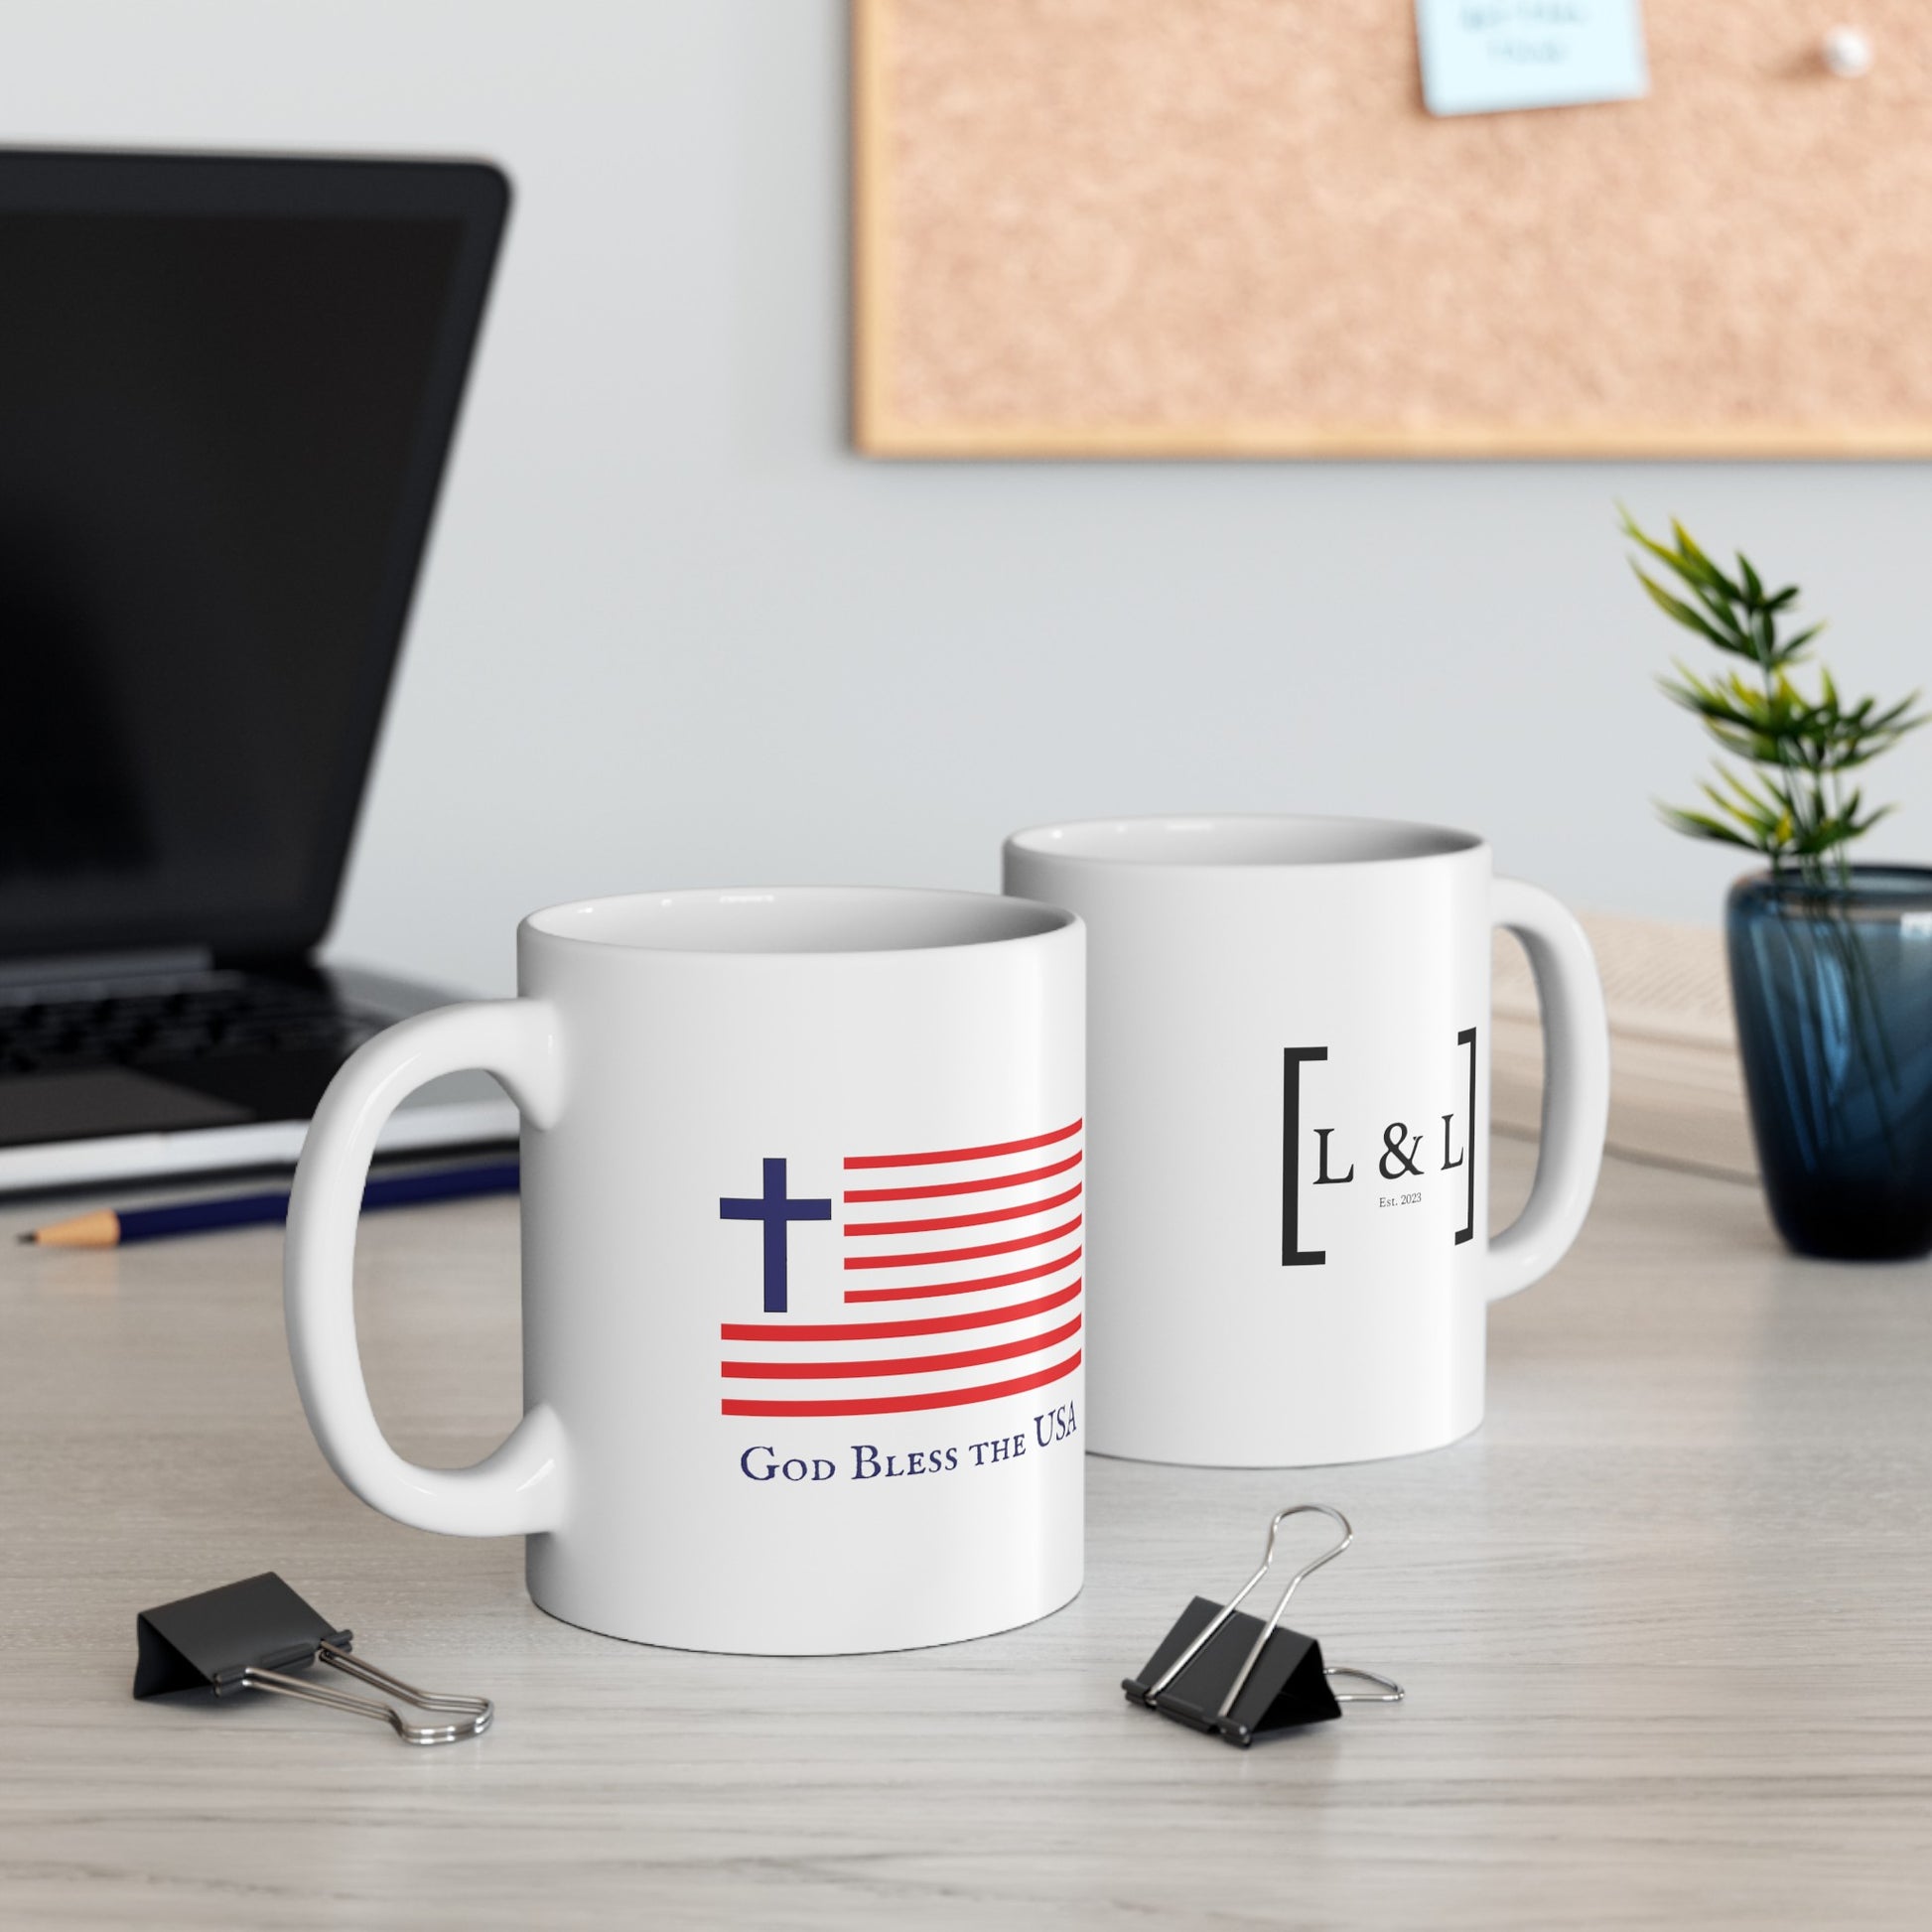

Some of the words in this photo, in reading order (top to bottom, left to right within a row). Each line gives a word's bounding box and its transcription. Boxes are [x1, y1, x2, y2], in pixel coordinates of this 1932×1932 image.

[1311, 1128, 1354, 1185] L
[1378, 1122, 1425, 1180] &
[1440, 1113, 1464, 1172] L
[1379, 1196, 1398, 1208] Est.
[1401, 1191, 1422, 1205] 2023
[1033, 1400, 1077, 1448] USA
